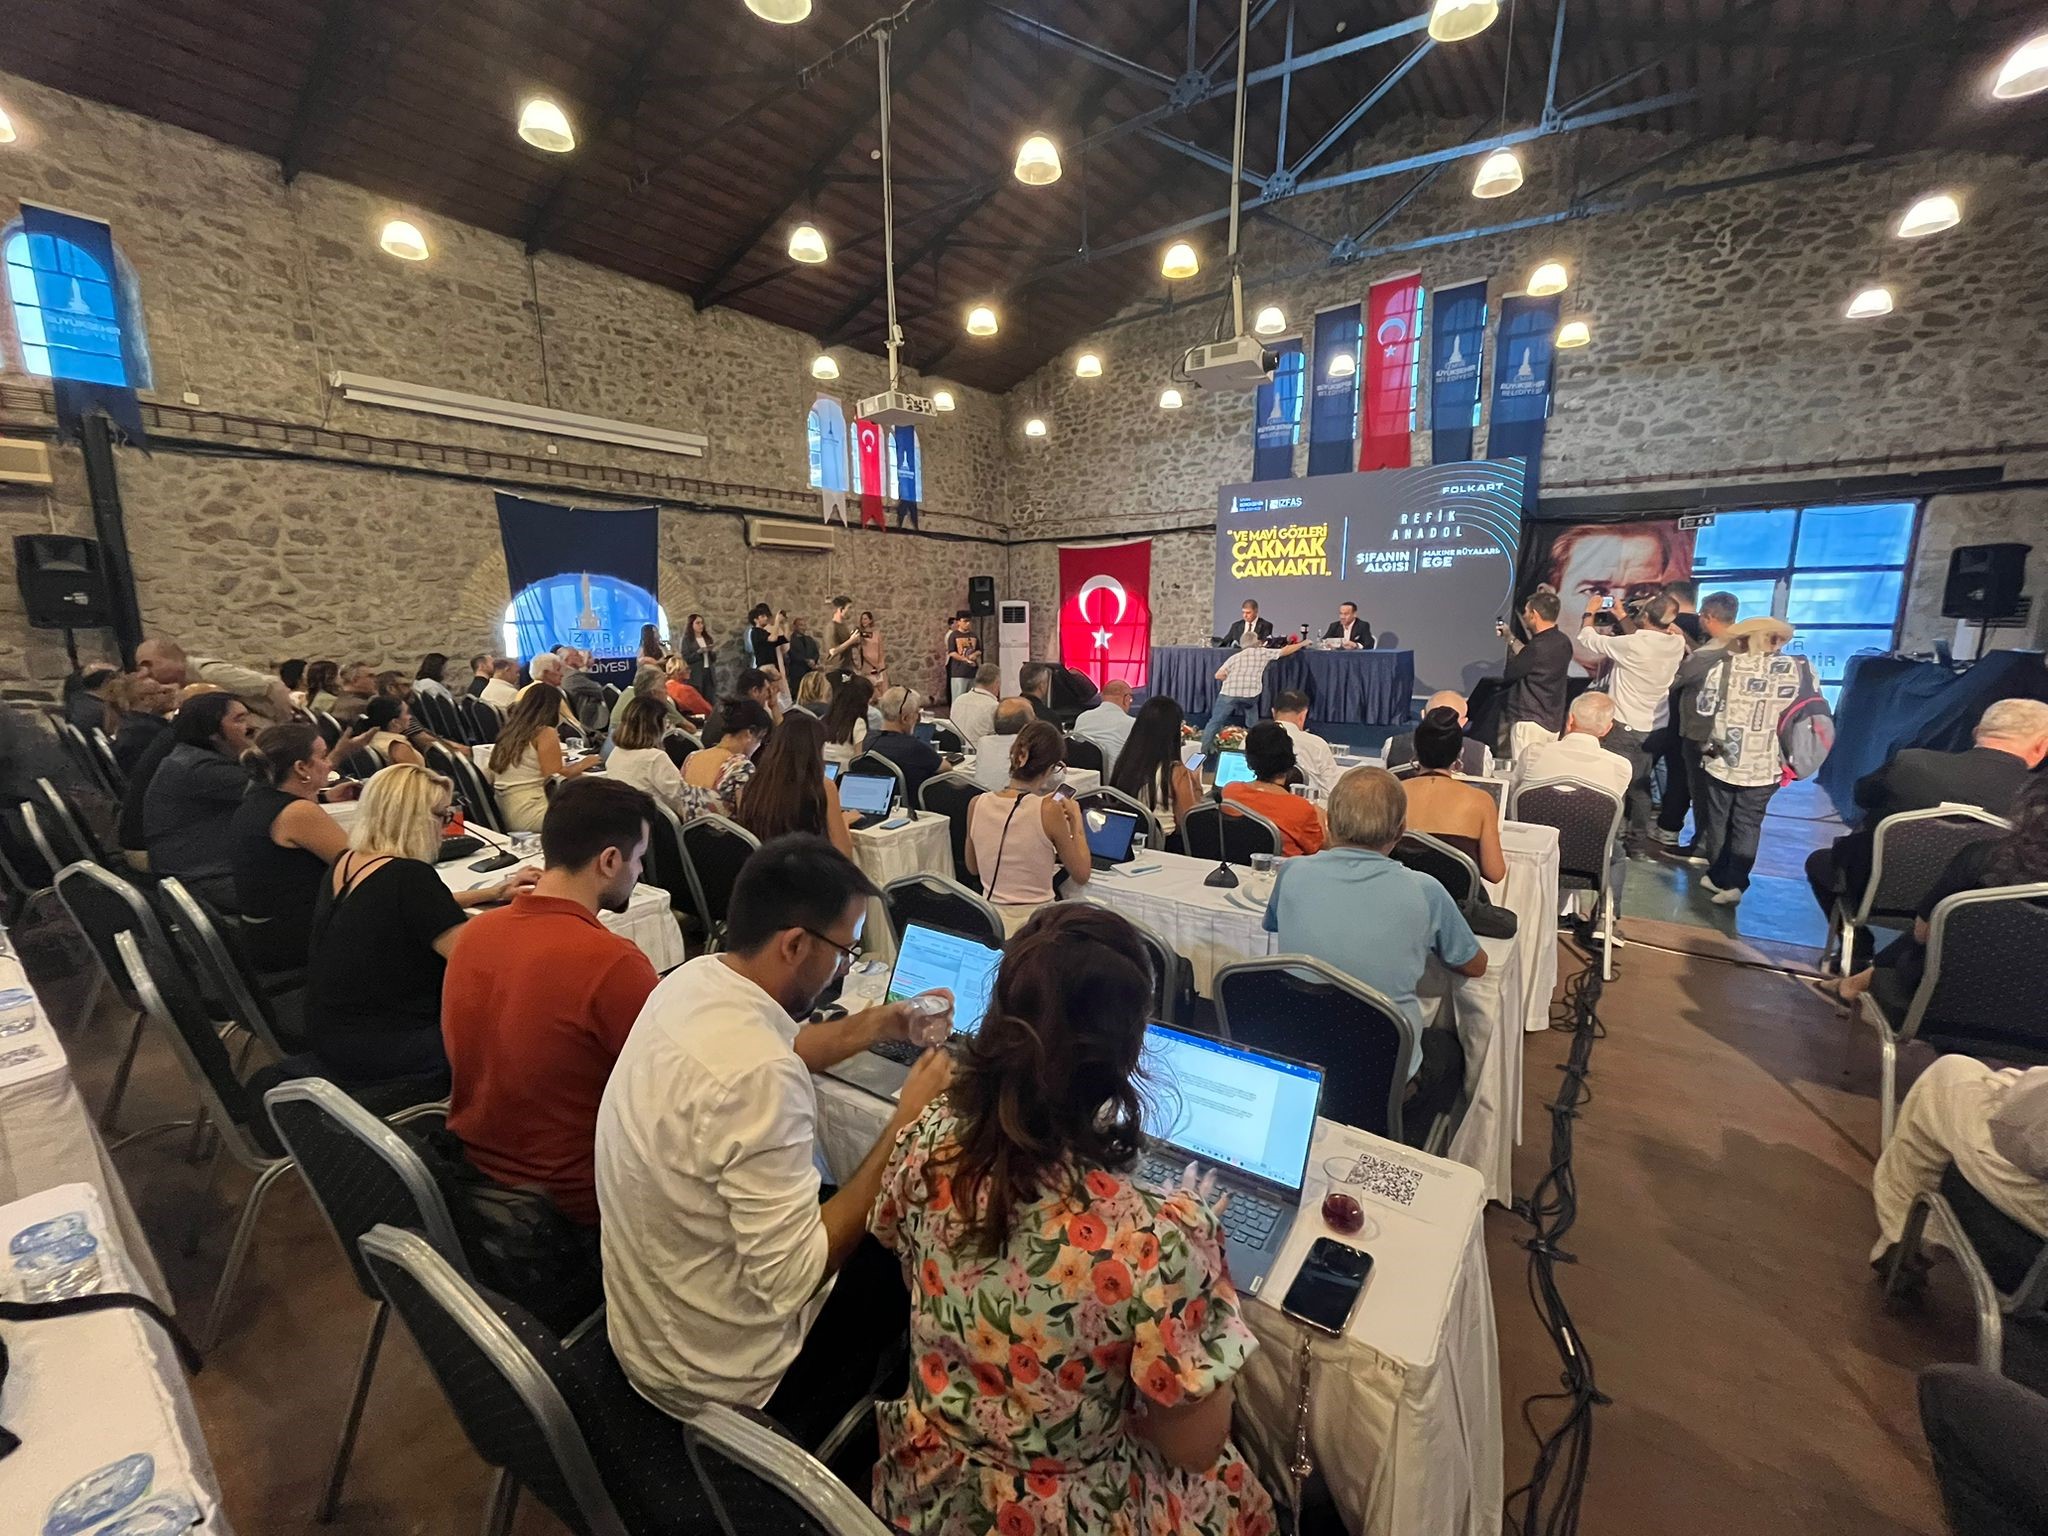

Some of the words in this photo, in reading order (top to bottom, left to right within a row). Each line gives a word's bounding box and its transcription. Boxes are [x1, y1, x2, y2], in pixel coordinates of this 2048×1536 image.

[1442, 483, 1504, 495] FOLKART
[1401, 509, 1457, 525] REFİK
[1248, 525, 1277, 541] MAVİ
[1278, 522, 1327, 540] GÖZLERİ
[1391, 526, 1463, 541] ANADOL
[1231, 537, 1327, 561] ÇAKMAK
[1364, 561, 1410, 573] ALGISI
[1422, 556, 1453, 568] EGE
